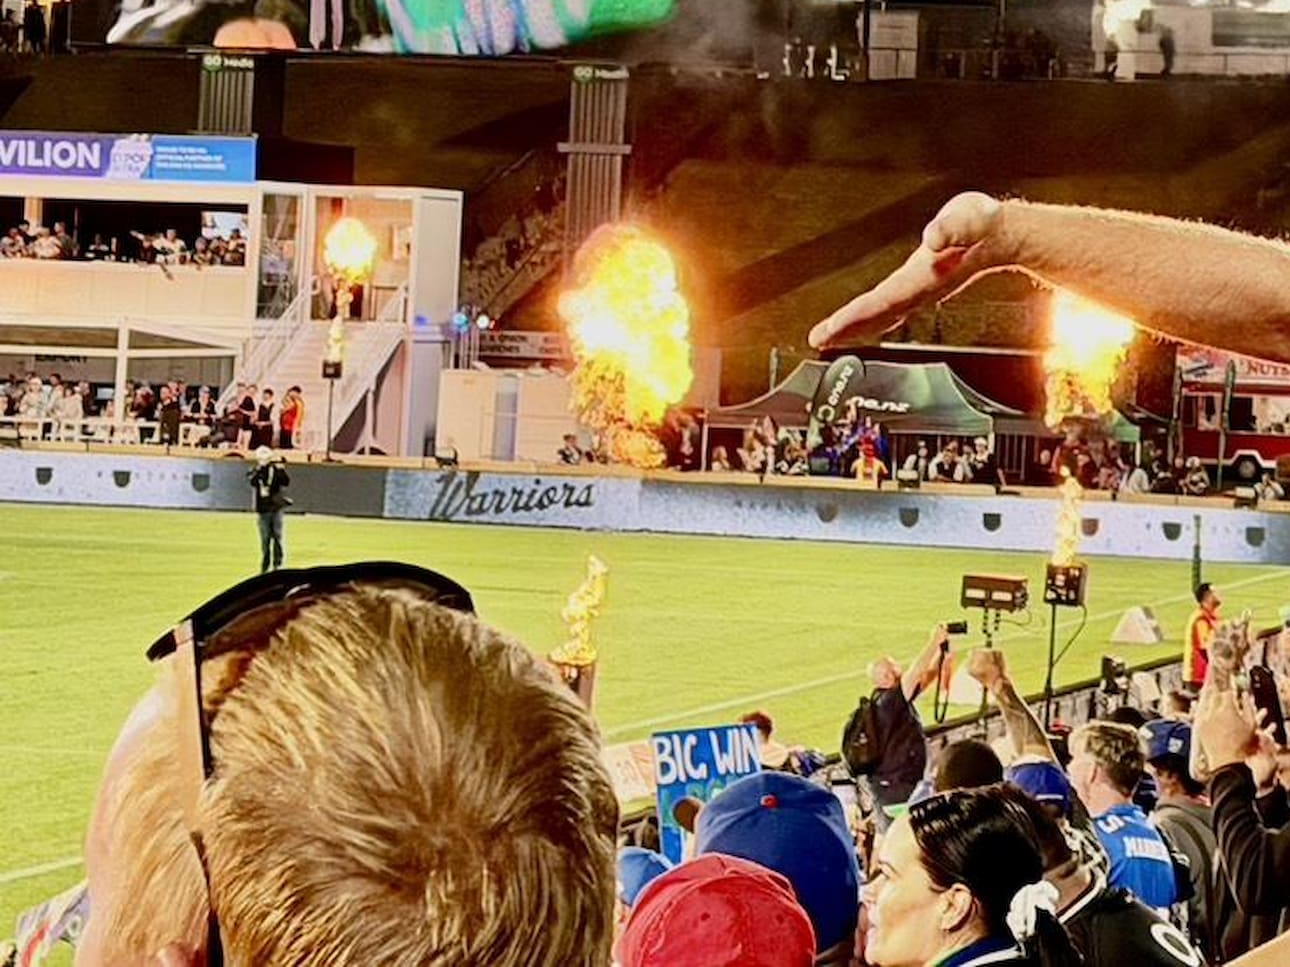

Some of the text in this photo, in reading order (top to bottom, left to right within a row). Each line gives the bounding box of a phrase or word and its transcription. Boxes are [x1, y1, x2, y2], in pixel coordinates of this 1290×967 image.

[0, 139, 100, 169] VILION
[430, 470, 595, 521] Warriors
[654, 734, 708, 785] BIG
[708, 725, 762, 774] WIN
